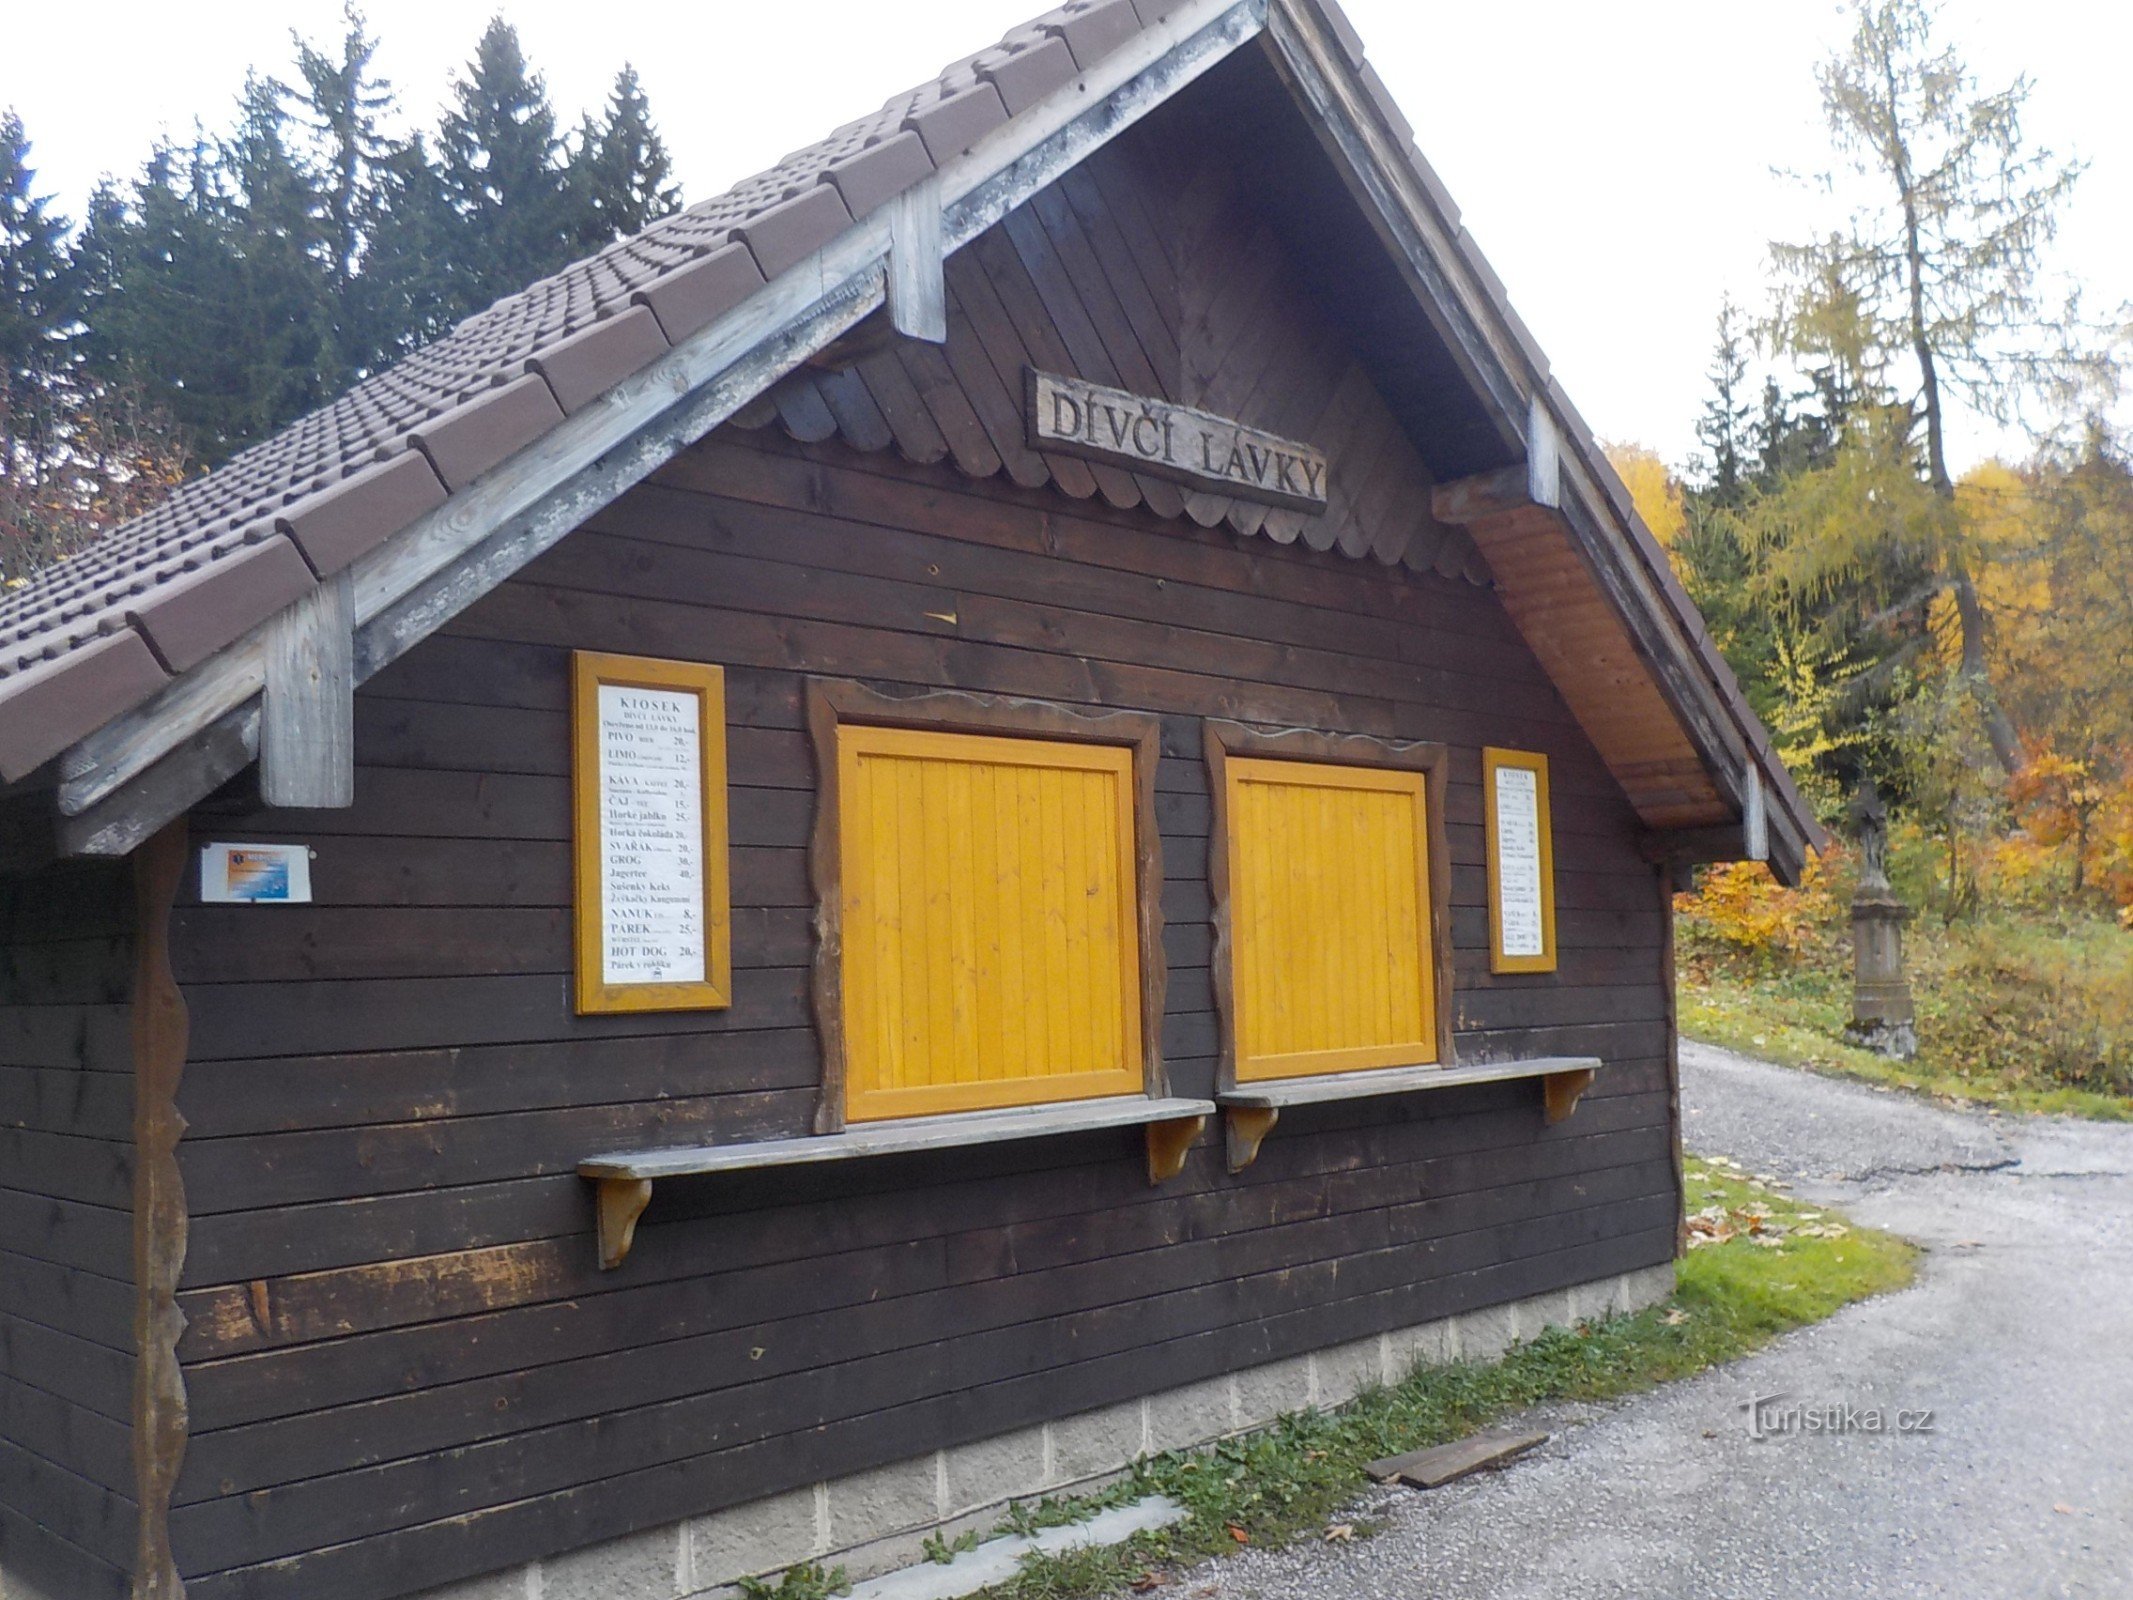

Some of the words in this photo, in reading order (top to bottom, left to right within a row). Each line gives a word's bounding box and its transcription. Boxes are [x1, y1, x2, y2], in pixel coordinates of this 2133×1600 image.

[1051, 390, 1176, 463] DÍVČÍ
[1198, 427, 1324, 498] LÁVKY
[620, 697, 681, 713] KIOSEK
[608, 731, 634, 742] PIVO
[608, 749, 637, 760] LIMO
[609, 794, 629, 806] ČAJ
[610, 855, 642, 865] GROG
[650, 882, 671, 891] Keks
[612, 908, 653, 919] NANUK
[611, 946, 636, 957] HOT
[642, 946, 667, 957] DOG
